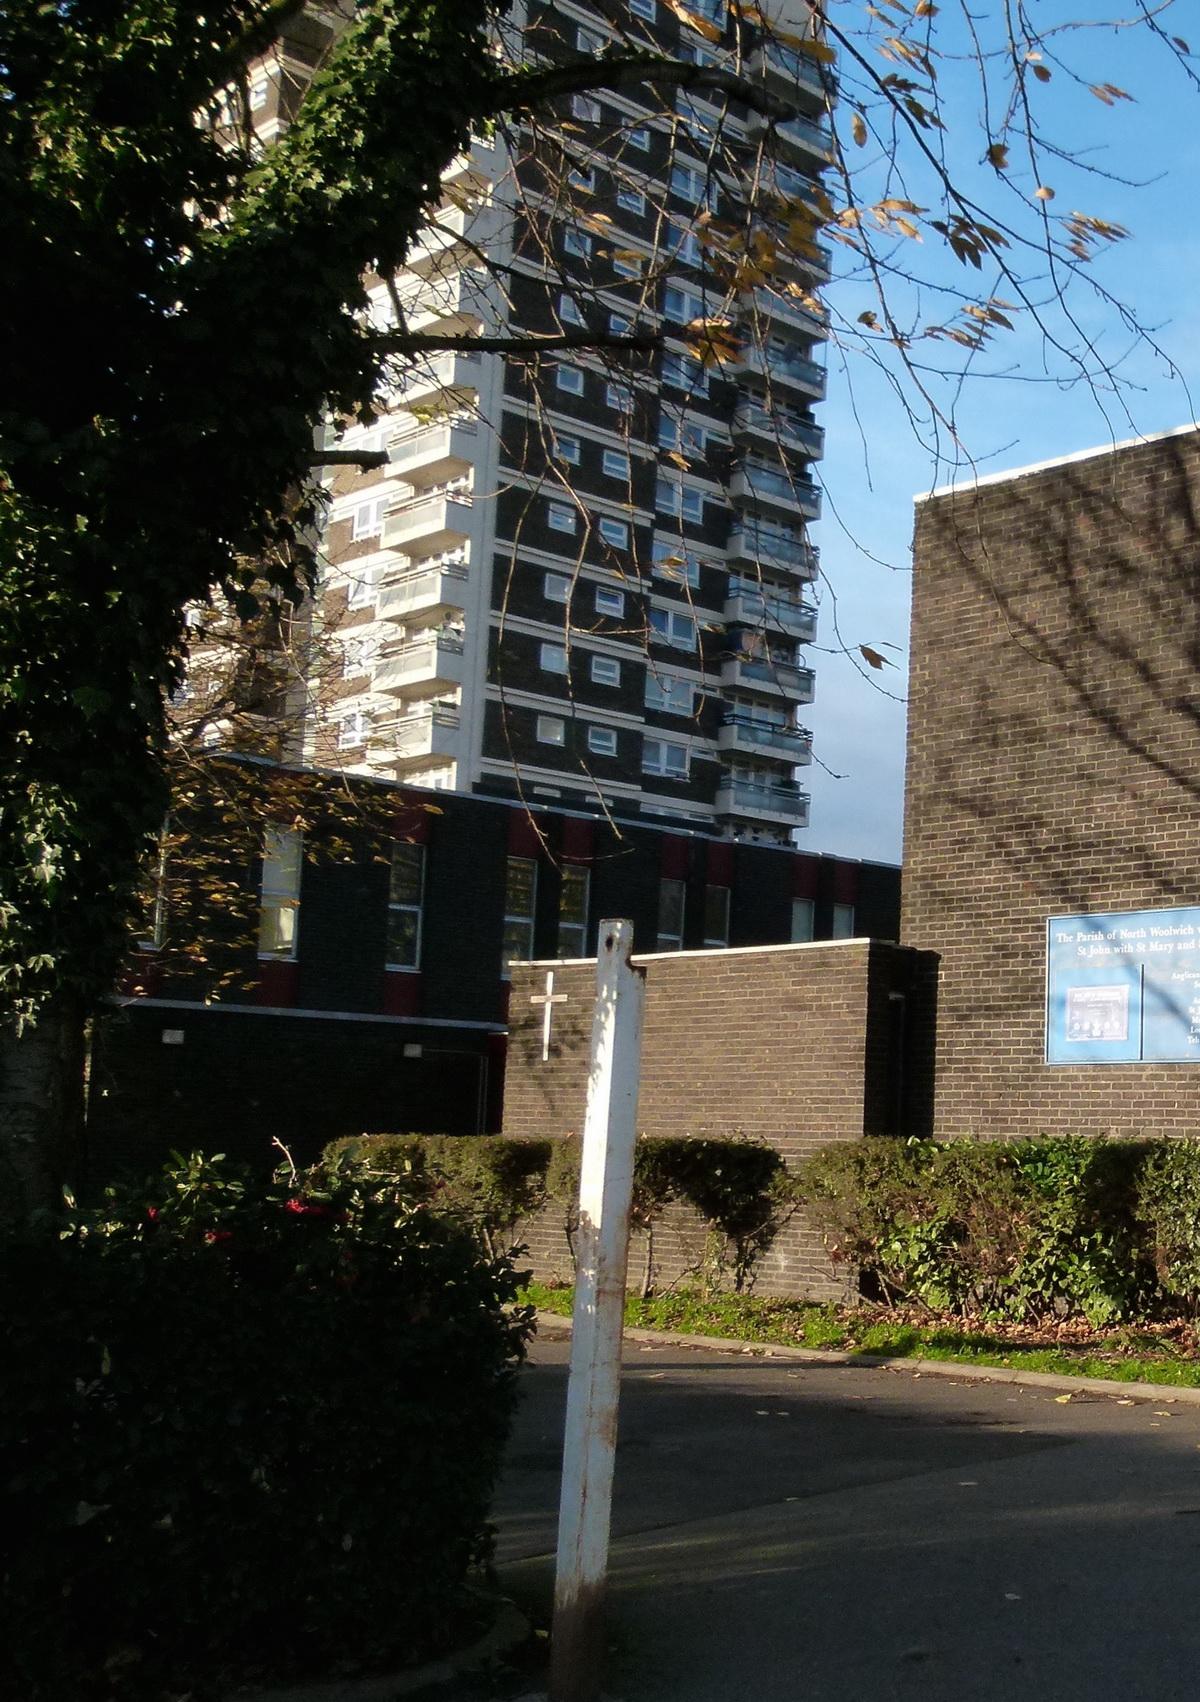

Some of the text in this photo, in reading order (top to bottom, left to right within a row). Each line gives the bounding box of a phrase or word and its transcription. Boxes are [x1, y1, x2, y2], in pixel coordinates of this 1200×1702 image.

[1056, 932, 1073, 943] The
[1077, 931, 1103, 941] Parish
[1107, 929, 1116, 940] of
[1120, 928, 1146, 939] North
[1151, 924, 1194, 937] Woolwich
[1077, 947, 1087, 955] St
[1088, 944, 1111, 957] John
[1114, 943, 1133, 953] with
[1137, 942, 1146, 952] St
[1150, 941, 1173, 953] Mary
[1177, 940, 1195, 949] and
[1172, 971, 1199, 981] Anglican
